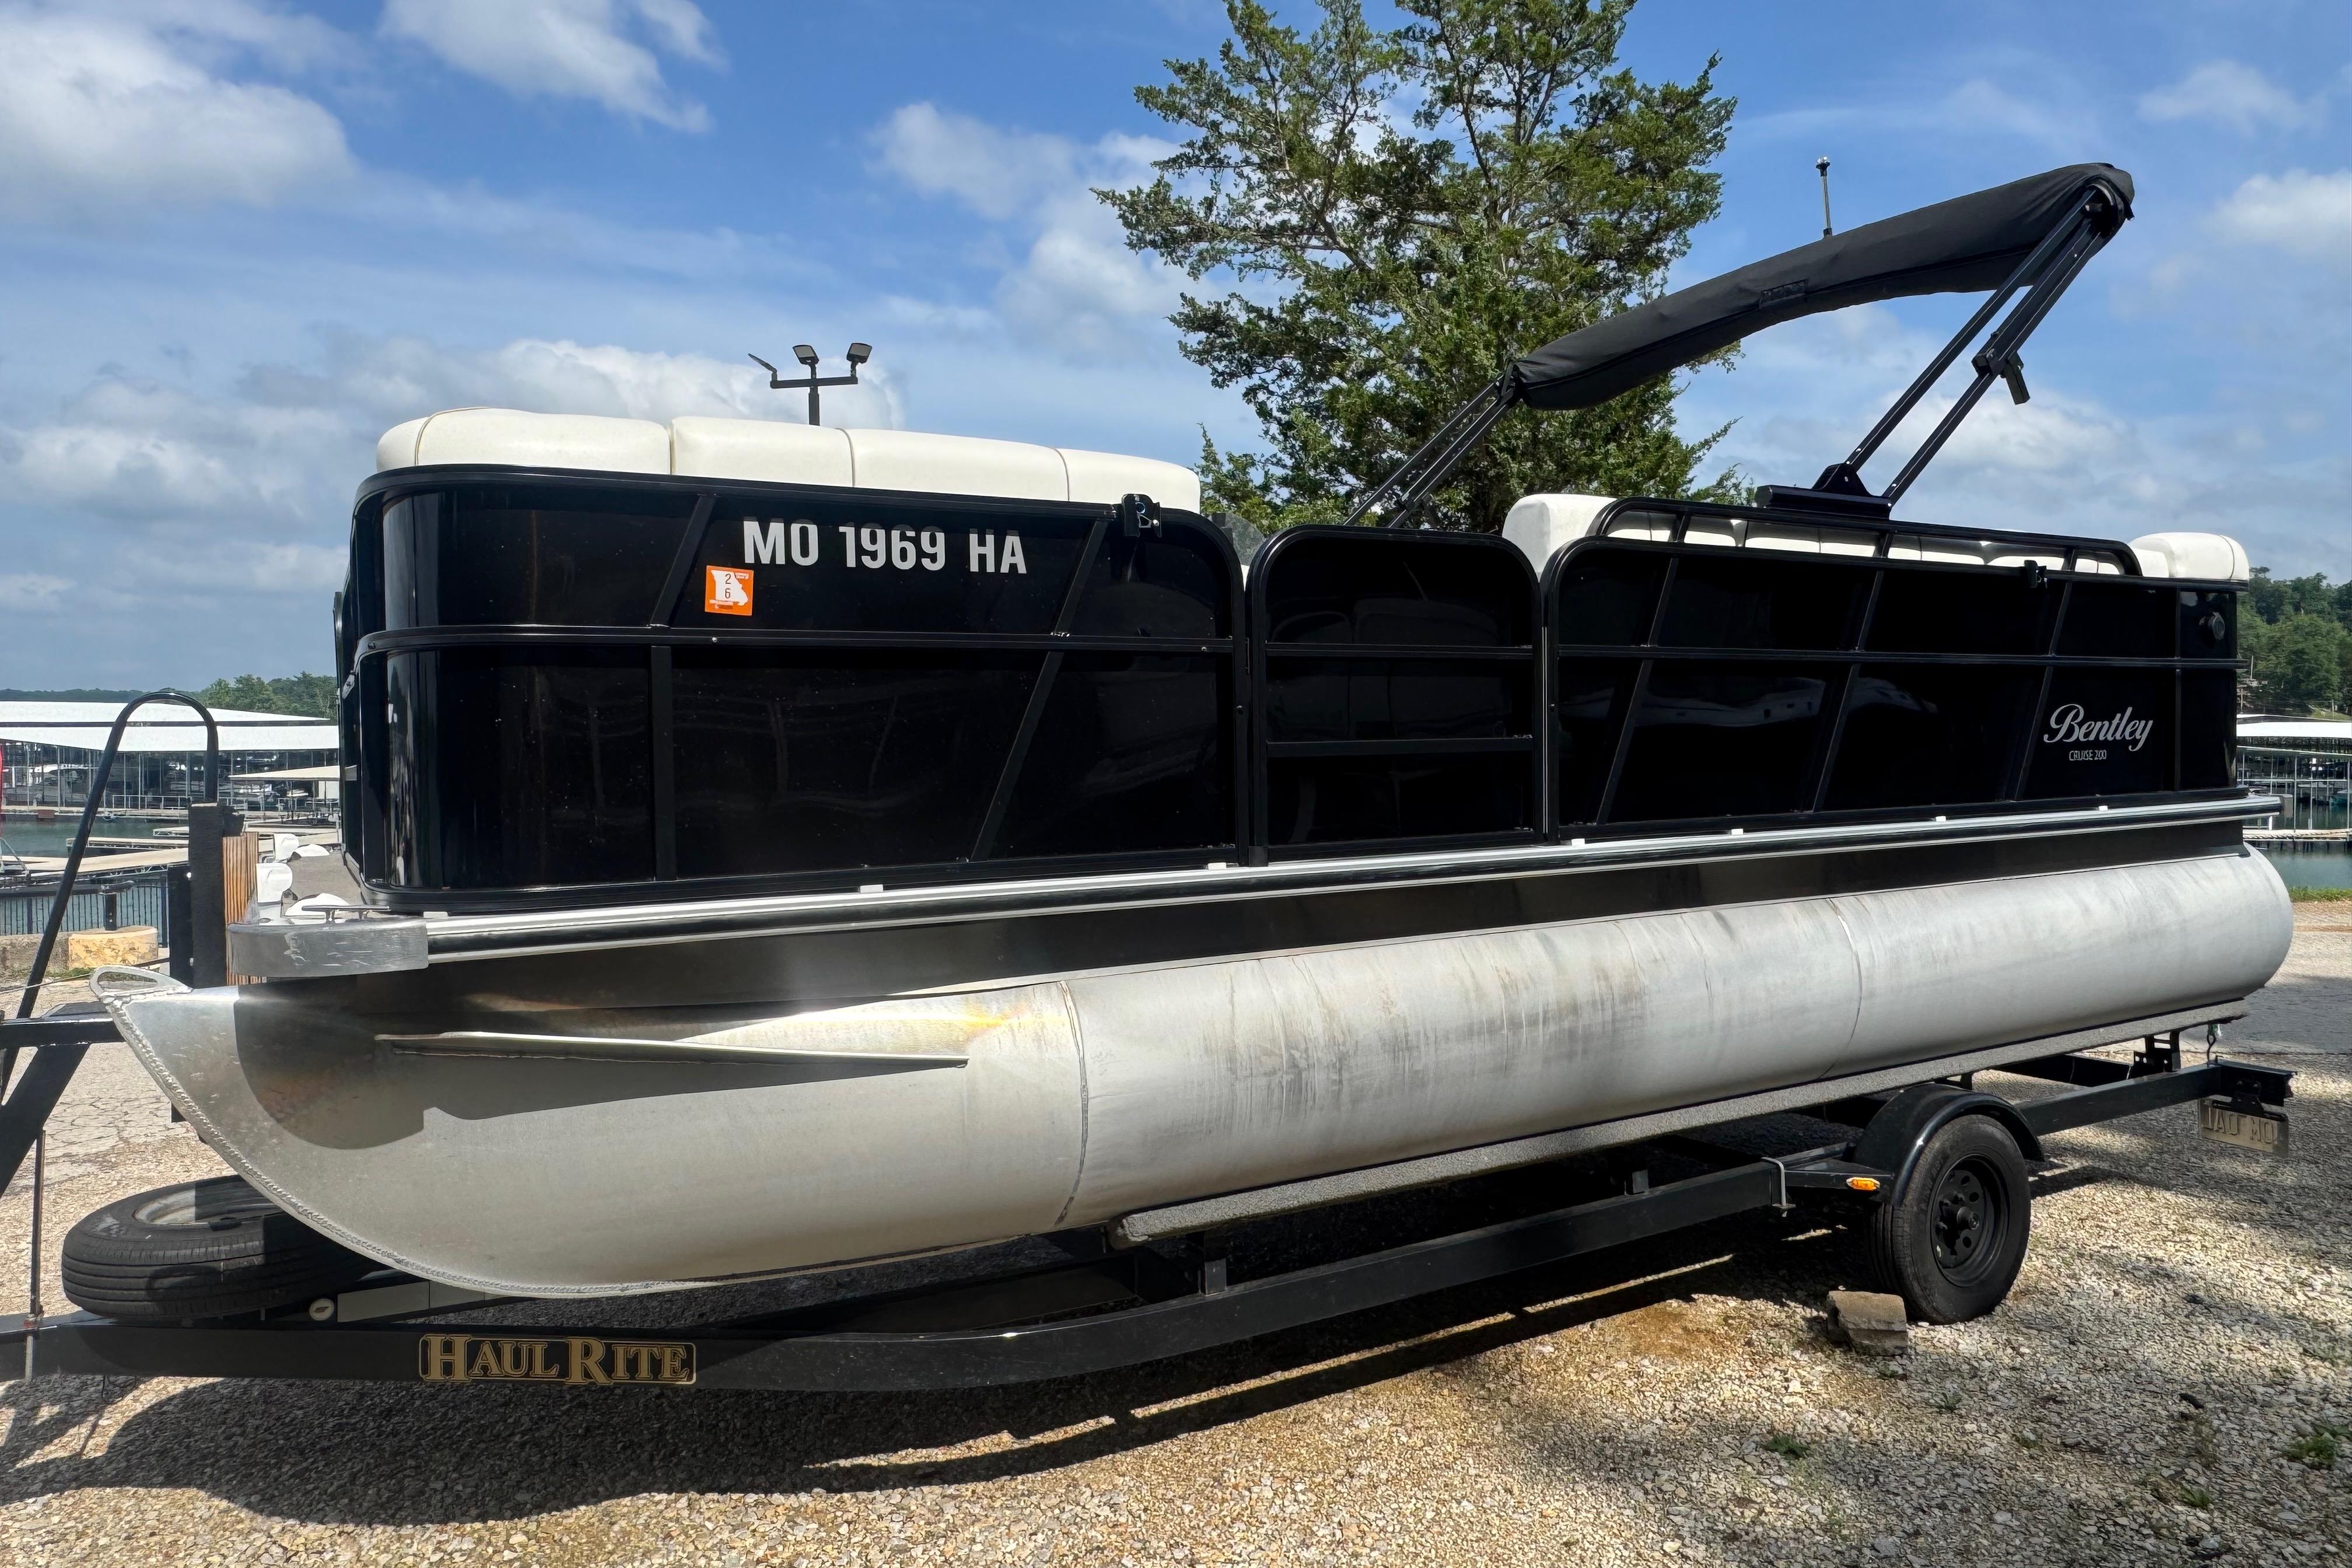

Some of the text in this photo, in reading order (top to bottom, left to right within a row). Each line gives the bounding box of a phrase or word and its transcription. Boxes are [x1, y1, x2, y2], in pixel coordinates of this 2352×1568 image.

[743, 516, 1027, 574] MO 1969 HA
[724, 573, 732, 584] 2
[724, 587, 731, 599] 6
[2043, 704, 2154, 751] Bentley
[421, 1334, 691, 1385] HAUL RITE
